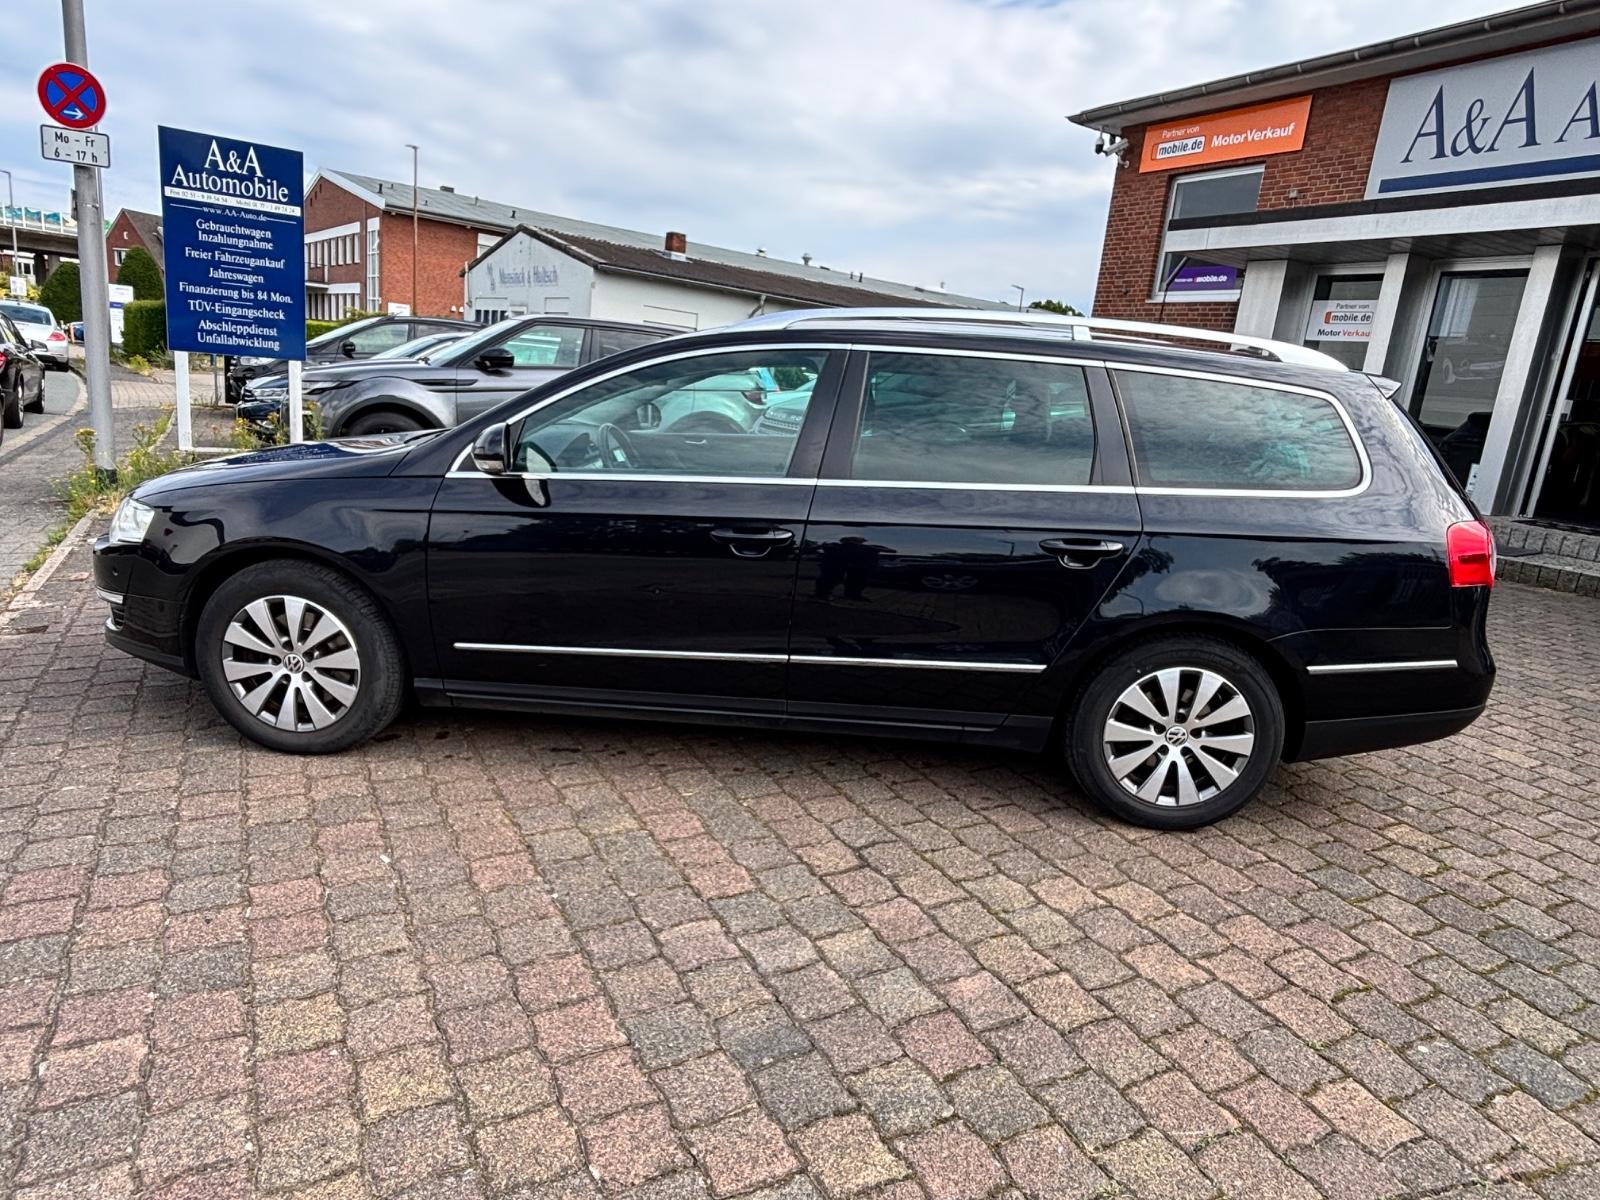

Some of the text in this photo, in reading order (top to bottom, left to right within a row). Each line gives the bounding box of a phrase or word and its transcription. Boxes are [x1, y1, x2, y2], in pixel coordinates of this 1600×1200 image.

[1400, 67, 1541, 163] A&A
[55, 131, 69, 144] Mo
[85, 136, 95, 147] Fr
[1162, 126, 1200, 138] Partner von
[54, 147, 60, 158] 6
[76, 150, 86, 161] 17
[92, 152, 98, 163] h
[1158, 138, 1203, 156] mobile.de
[204, 138, 264, 177] A&A
[171, 163, 289, 202] Automobile
[196, 218, 272, 239] Gebrauchtwagen
[198, 231, 274, 250] Inzahlungnahme
[185, 247, 285, 269] Freier Fahrzeugankauf
[208, 267, 264, 284] Jahreswagen
[179, 281, 293, 304] Finanzierung bis 84 Mon.
[188, 299, 286, 319] TÜV-Eingangscheck
[1331, 313, 1371, 322] mobile.de
[199, 320, 278, 336] Abschleppdienst
[197, 332, 280, 351] Unfallabwicklung
